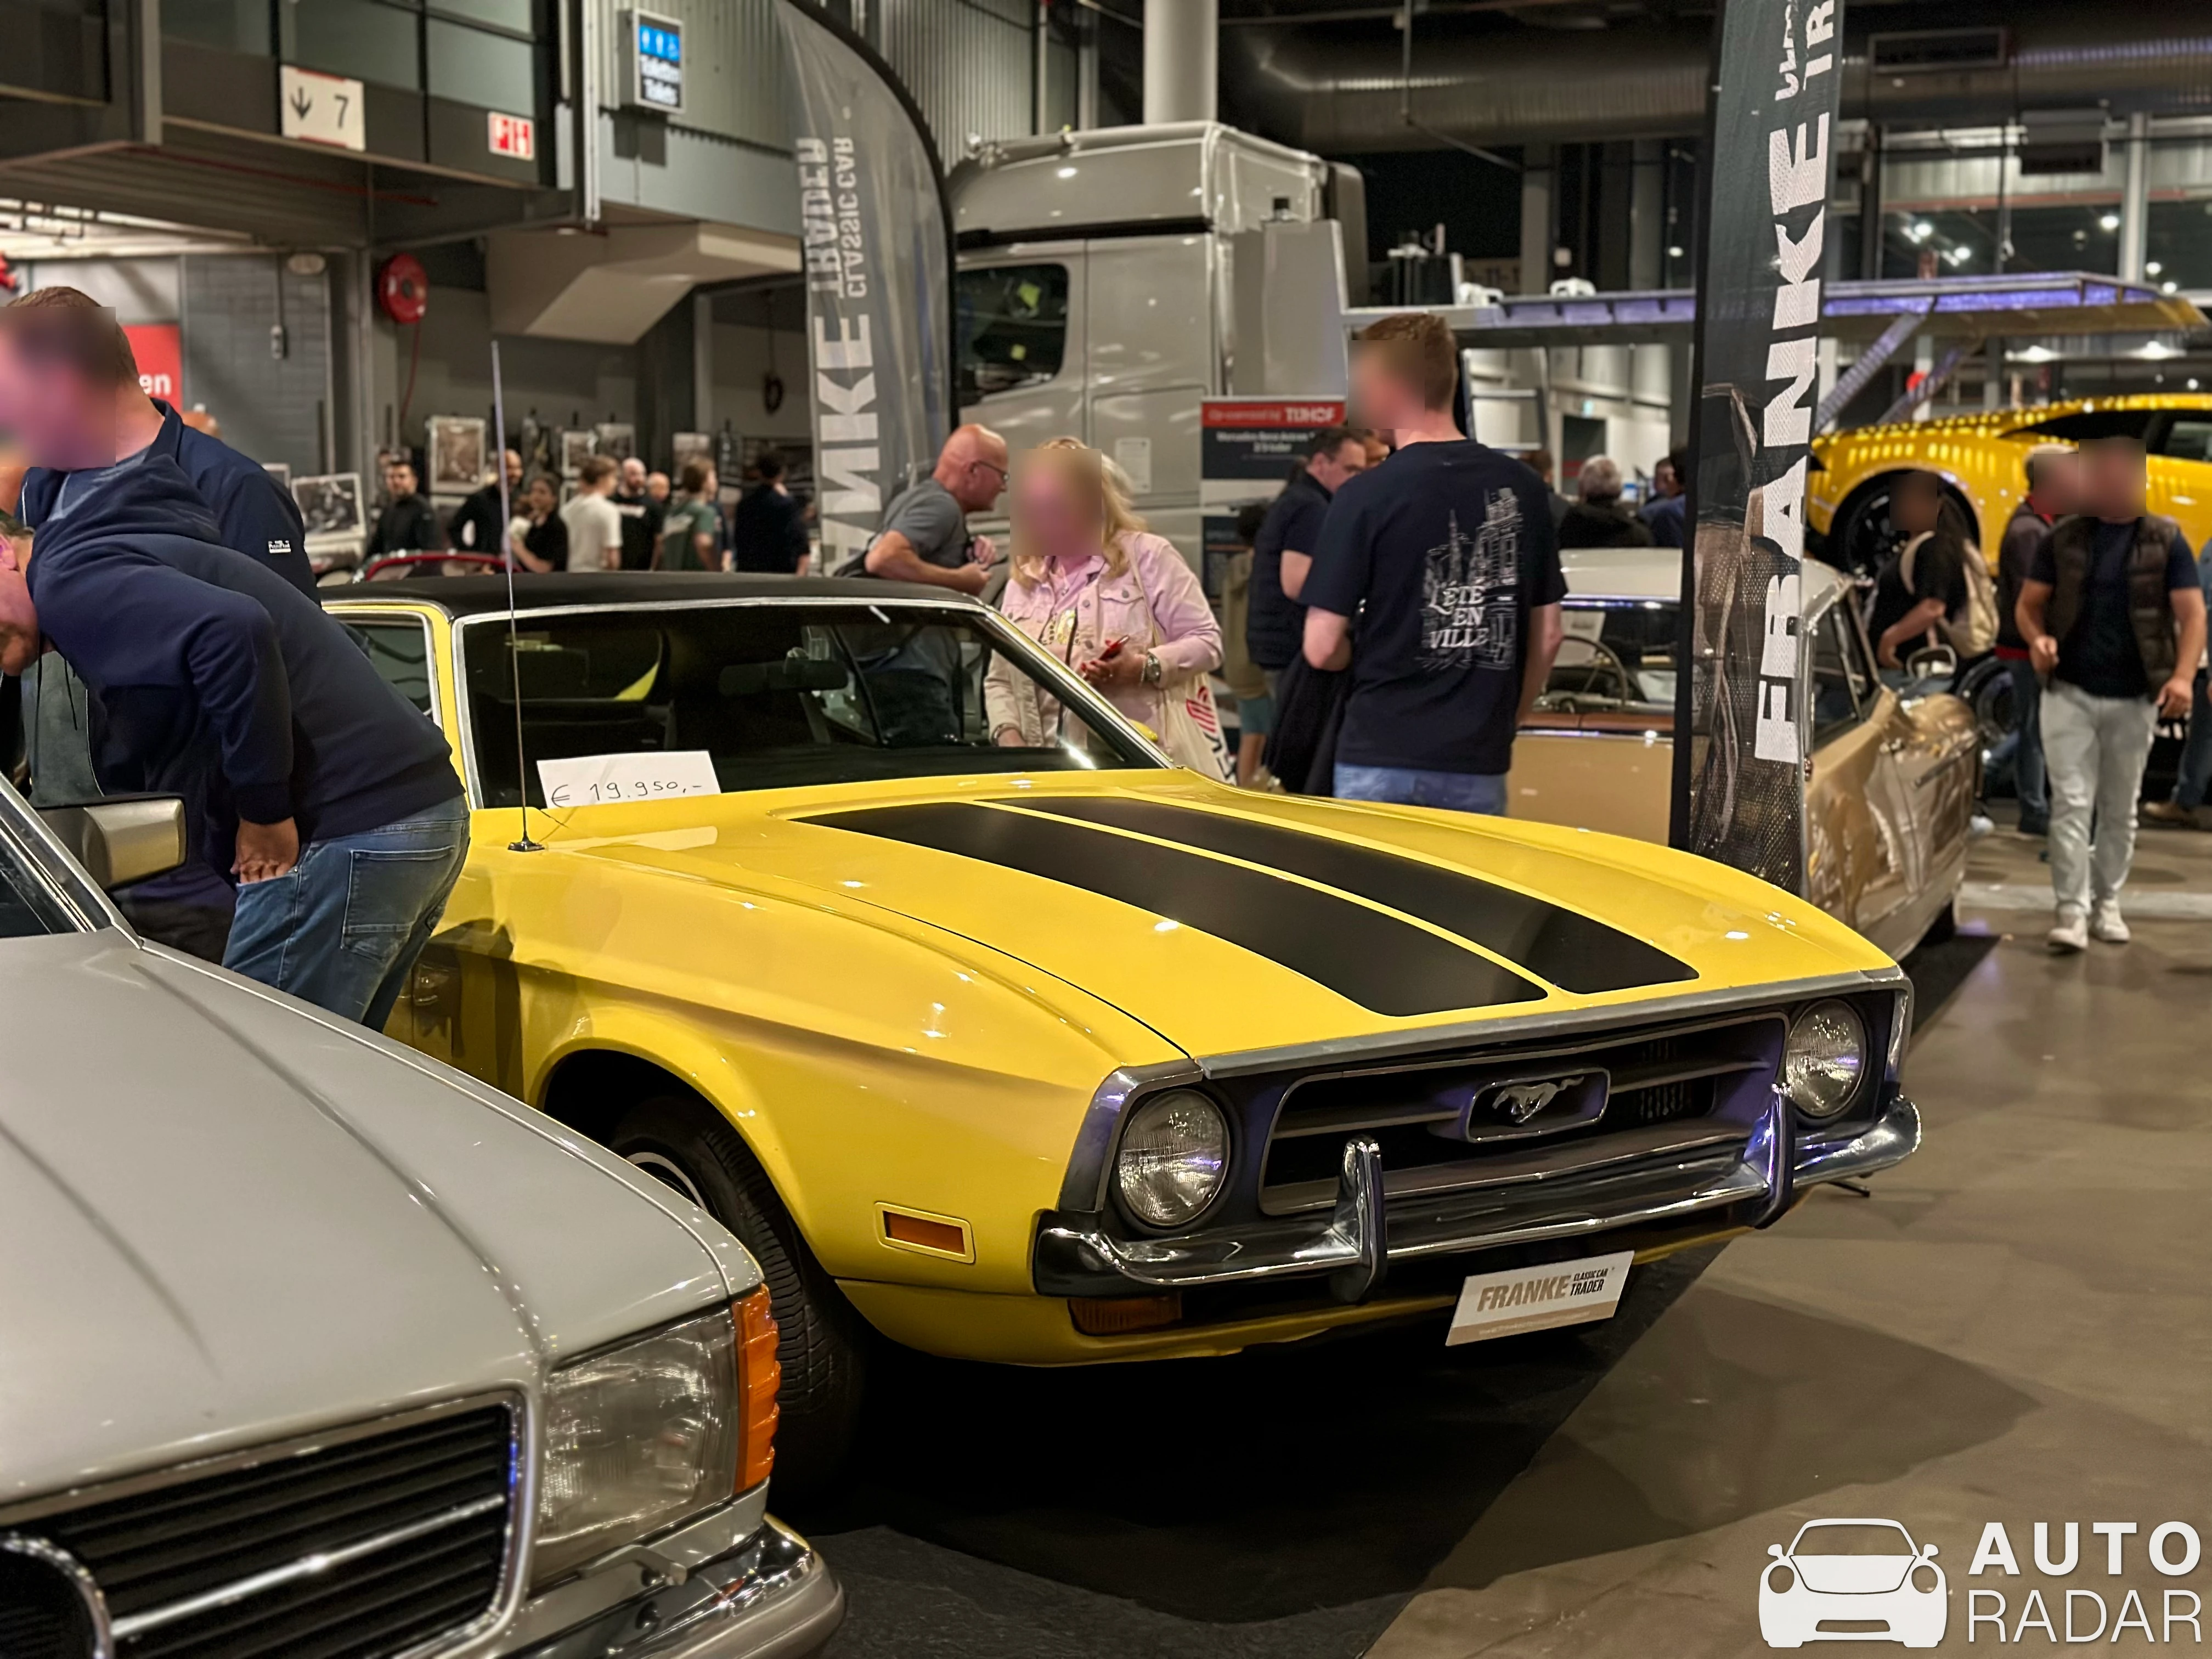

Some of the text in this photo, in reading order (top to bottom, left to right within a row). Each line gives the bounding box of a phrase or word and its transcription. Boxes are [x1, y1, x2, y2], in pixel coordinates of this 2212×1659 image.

[334, 93, 349, 130] 7
[1754, 112, 1830, 764] FRANKE
[1452, 606, 1486, 627] EN
[1427, 628, 1489, 649] VILLE
[1476, 1275, 1571, 1312] FRANKE
[1570, 1279, 1605, 1296] TRADER
